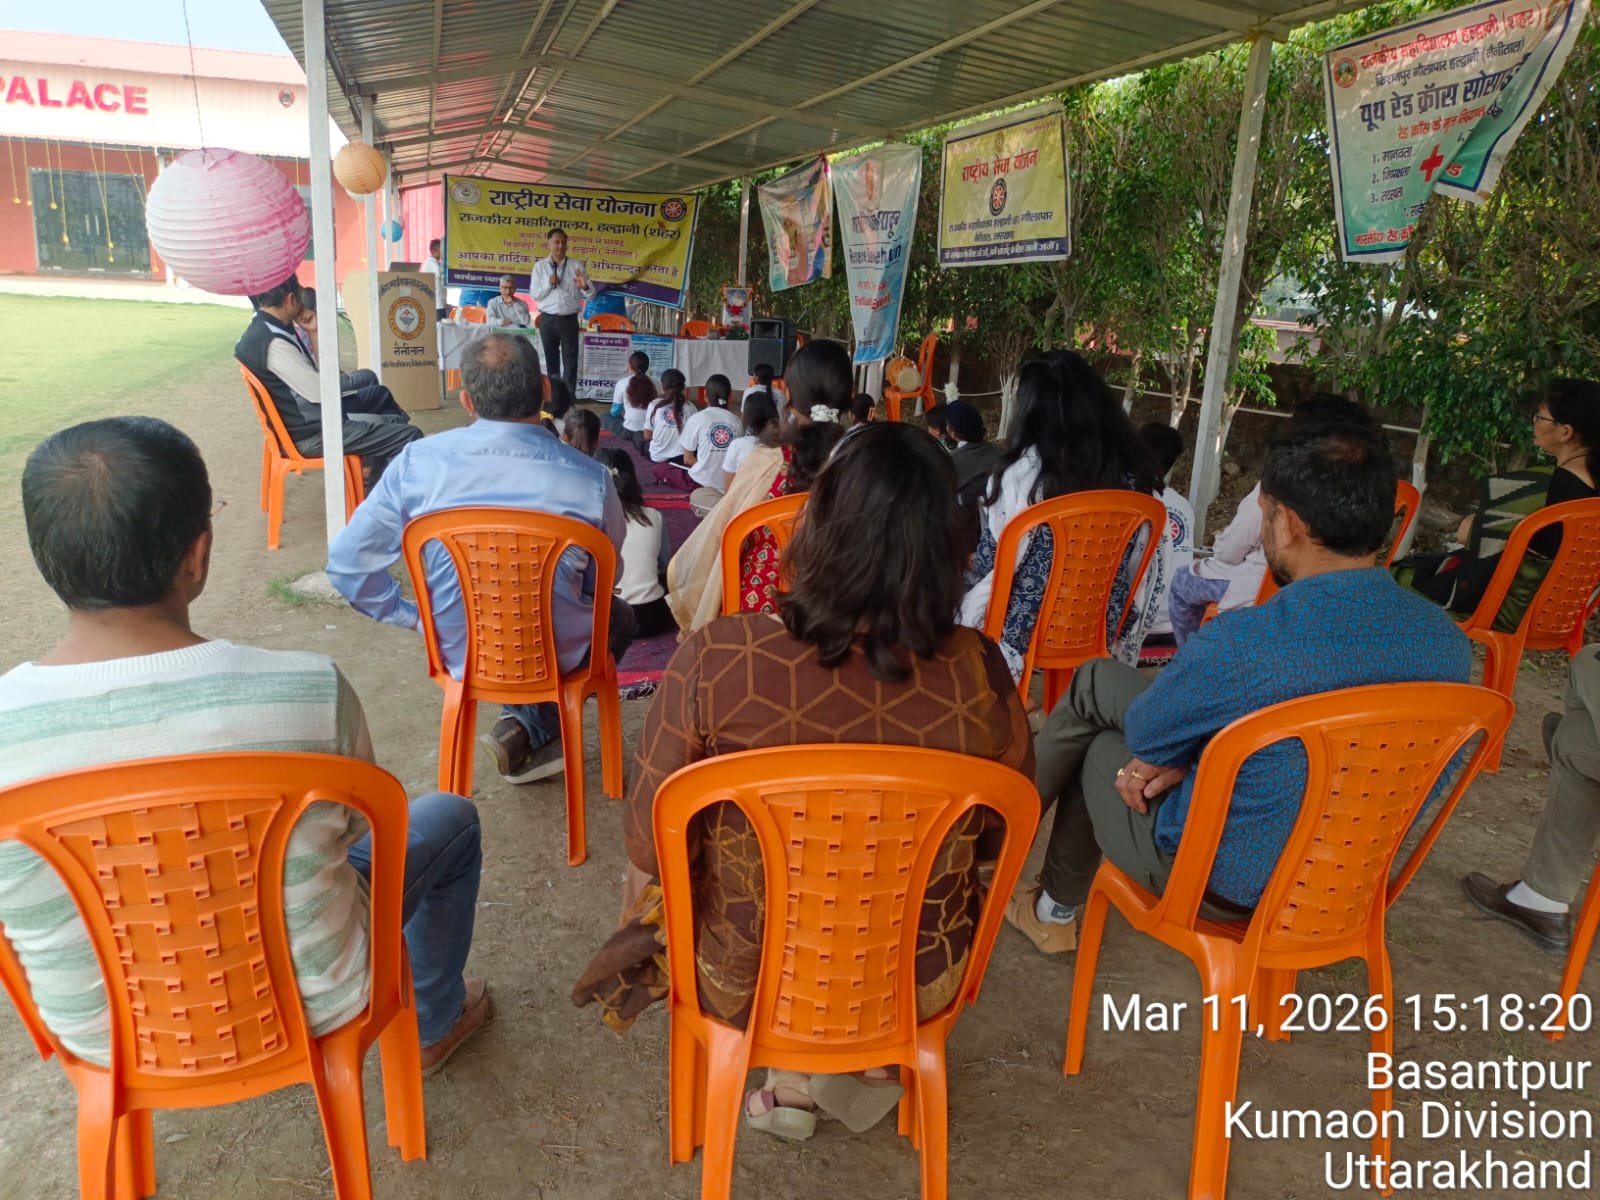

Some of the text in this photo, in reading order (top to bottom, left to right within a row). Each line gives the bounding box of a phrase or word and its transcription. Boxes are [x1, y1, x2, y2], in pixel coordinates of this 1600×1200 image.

[1360, 43, 1397, 69] राजकीय
[1398, 32, 1459, 58] महाविद्यालय
[1460, 12, 1499, 44] हल्द्वानी
[0, 75, 148, 115] ALACE
[1360, 99, 1386, 132] यूथ
[1390, 91, 1414, 119] रेड
[1417, 82, 1460, 114] क्रॉस
[992, 152, 1011, 178] सेवा
[1382, 146, 1413, 162] मानवता
[488, 187, 658, 218] राष्ट्रीय सेवा योजना
[459, 212, 513, 226] राजकीय
[597, 221, 640, 236] हल्द्वानी
[457, 250, 495, 263] आपका
[498, 250, 532, 264] हार्दिक
